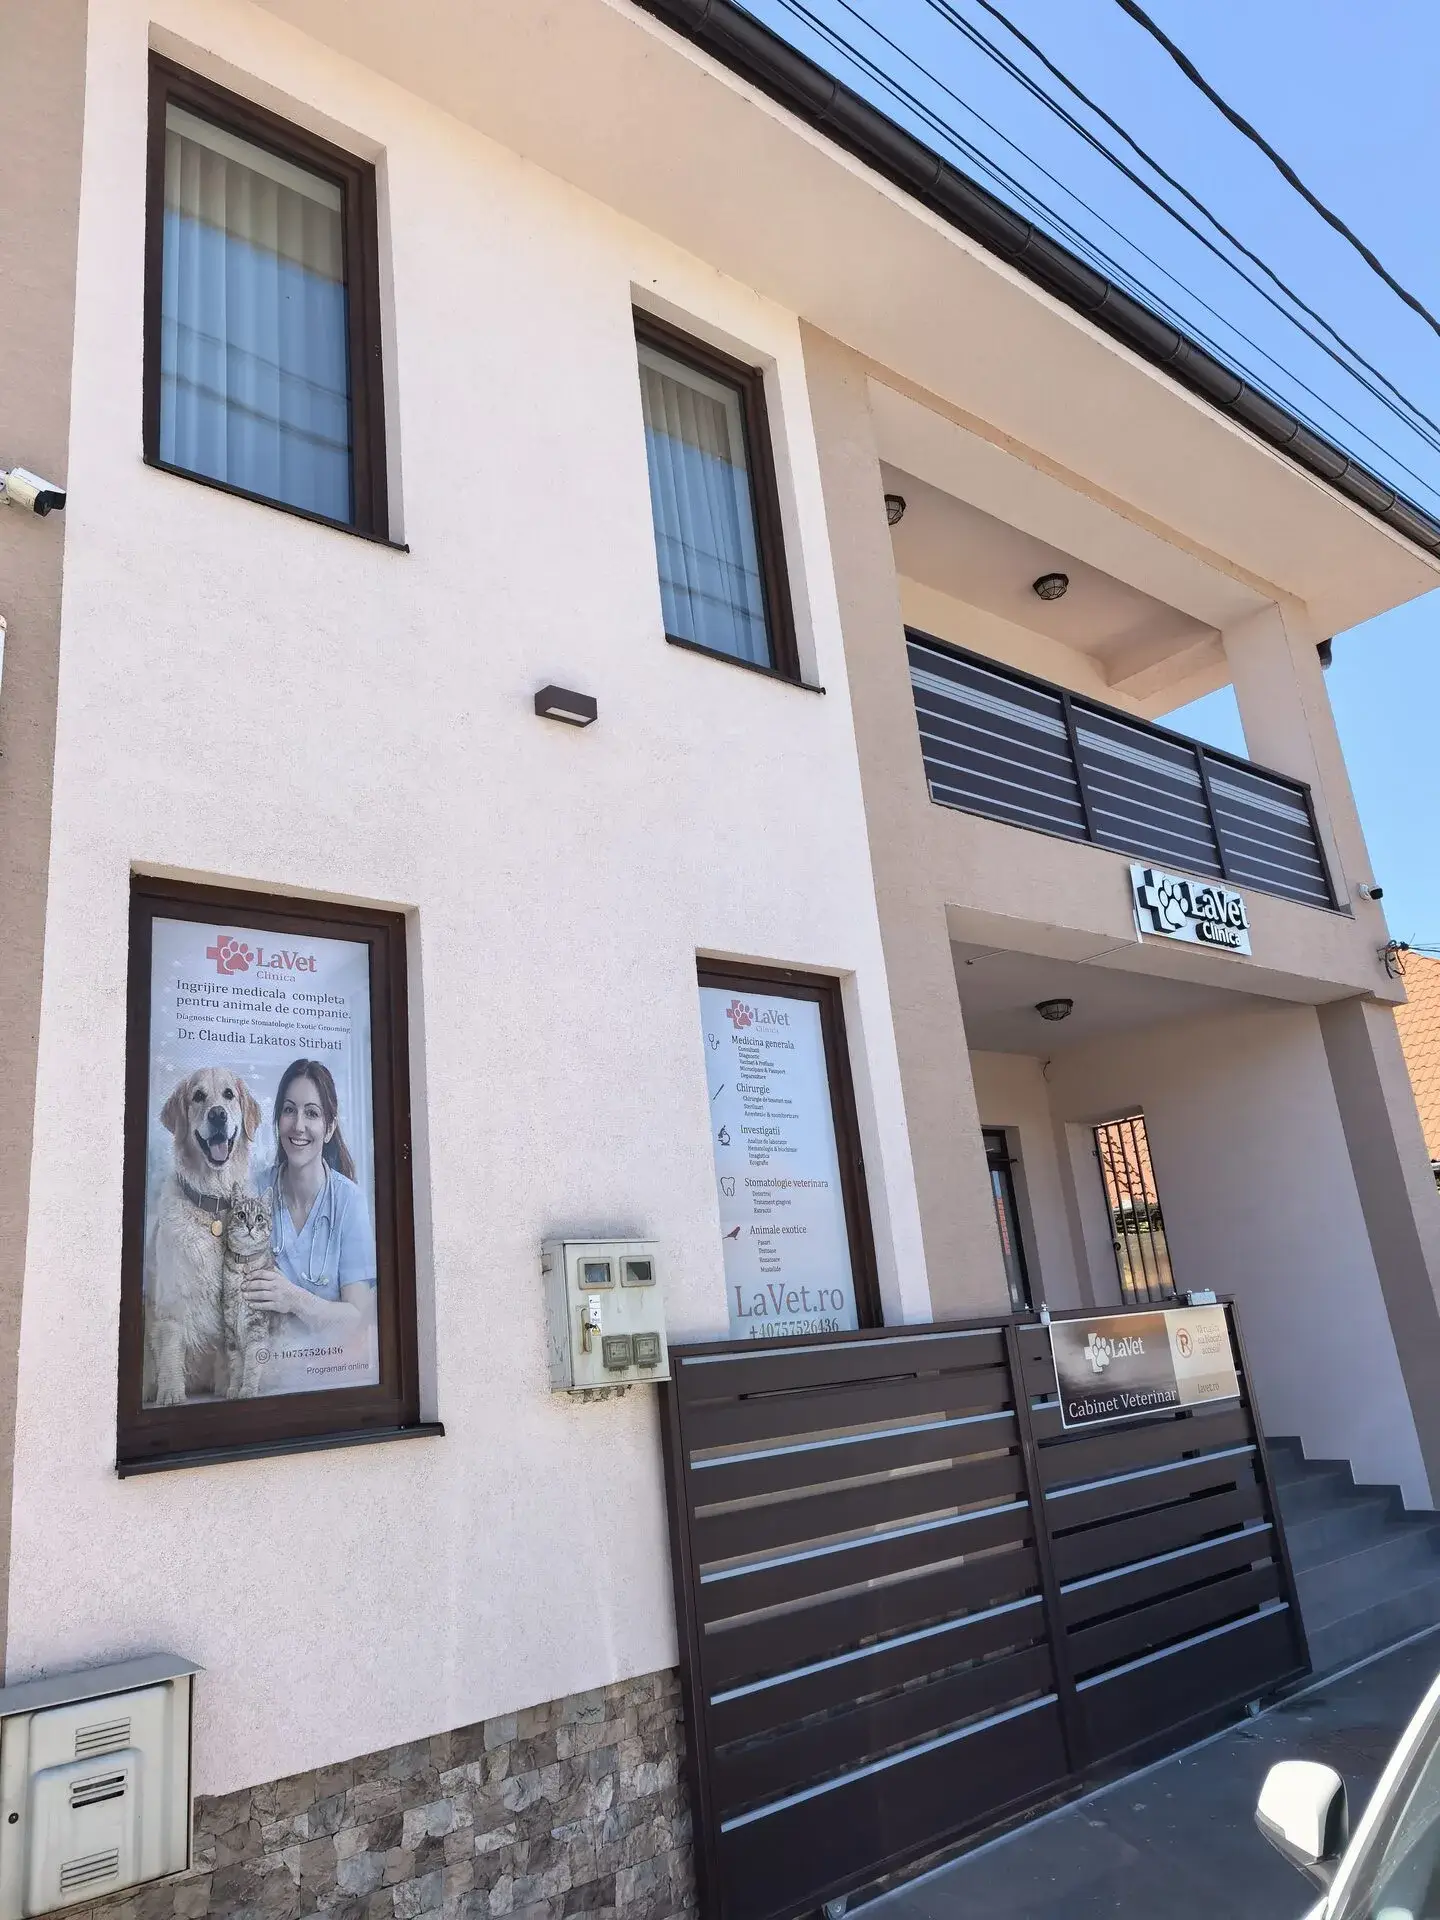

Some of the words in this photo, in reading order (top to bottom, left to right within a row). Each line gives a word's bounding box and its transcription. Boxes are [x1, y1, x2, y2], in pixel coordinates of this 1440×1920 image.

[1184, 882, 1250, 929] LaVet
[1199, 921, 1241, 946] Clinica
[255, 947, 318, 973] LaVet
[256, 970, 297, 983] Clinica
[176, 979, 229, 995] Ingrijire
[232, 986, 286, 1000] medicala
[292, 991, 345, 1006] completa
[176, 996, 220, 1008] pentru
[223, 1000, 272, 1013] animale
[275, 1003, 290, 1014] de
[176, 1013, 215, 1023] Diagnostic
[216, 1016, 249, 1026] Chirurgie
[251, 1019, 294, 1030] Stomatologie
[296, 1022, 316, 1031] Exotic
[754, 1008, 791, 1027] LaVet
[178, 1028, 195, 1040] Dr.
[199, 1029, 246, 1043] Claudia
[250, 1033, 296, 1047] Lakatos
[299, 1037, 343, 1051] Stirbati
[731, 1035, 764, 1047] Medicina
[765, 1039, 795, 1050] generala
[736, 1082, 770, 1095] Chirurgie
[744, 1178, 792, 1189] Stomatologie
[793, 1179, 829, 1188] veterinara
[750, 1225, 780, 1235] Animale
[781, 1225, 807, 1234] exotice
[734, 1283, 844, 1317] LaVet.ro
[1110, 1336, 1145, 1359] LaVet
[306, 1363, 347, 1375] Programari
[348, 1362, 369, 1371] online
[1068, 1397, 1119, 1418] Cabinet
[1120, 1389, 1177, 1408] Veterinar
